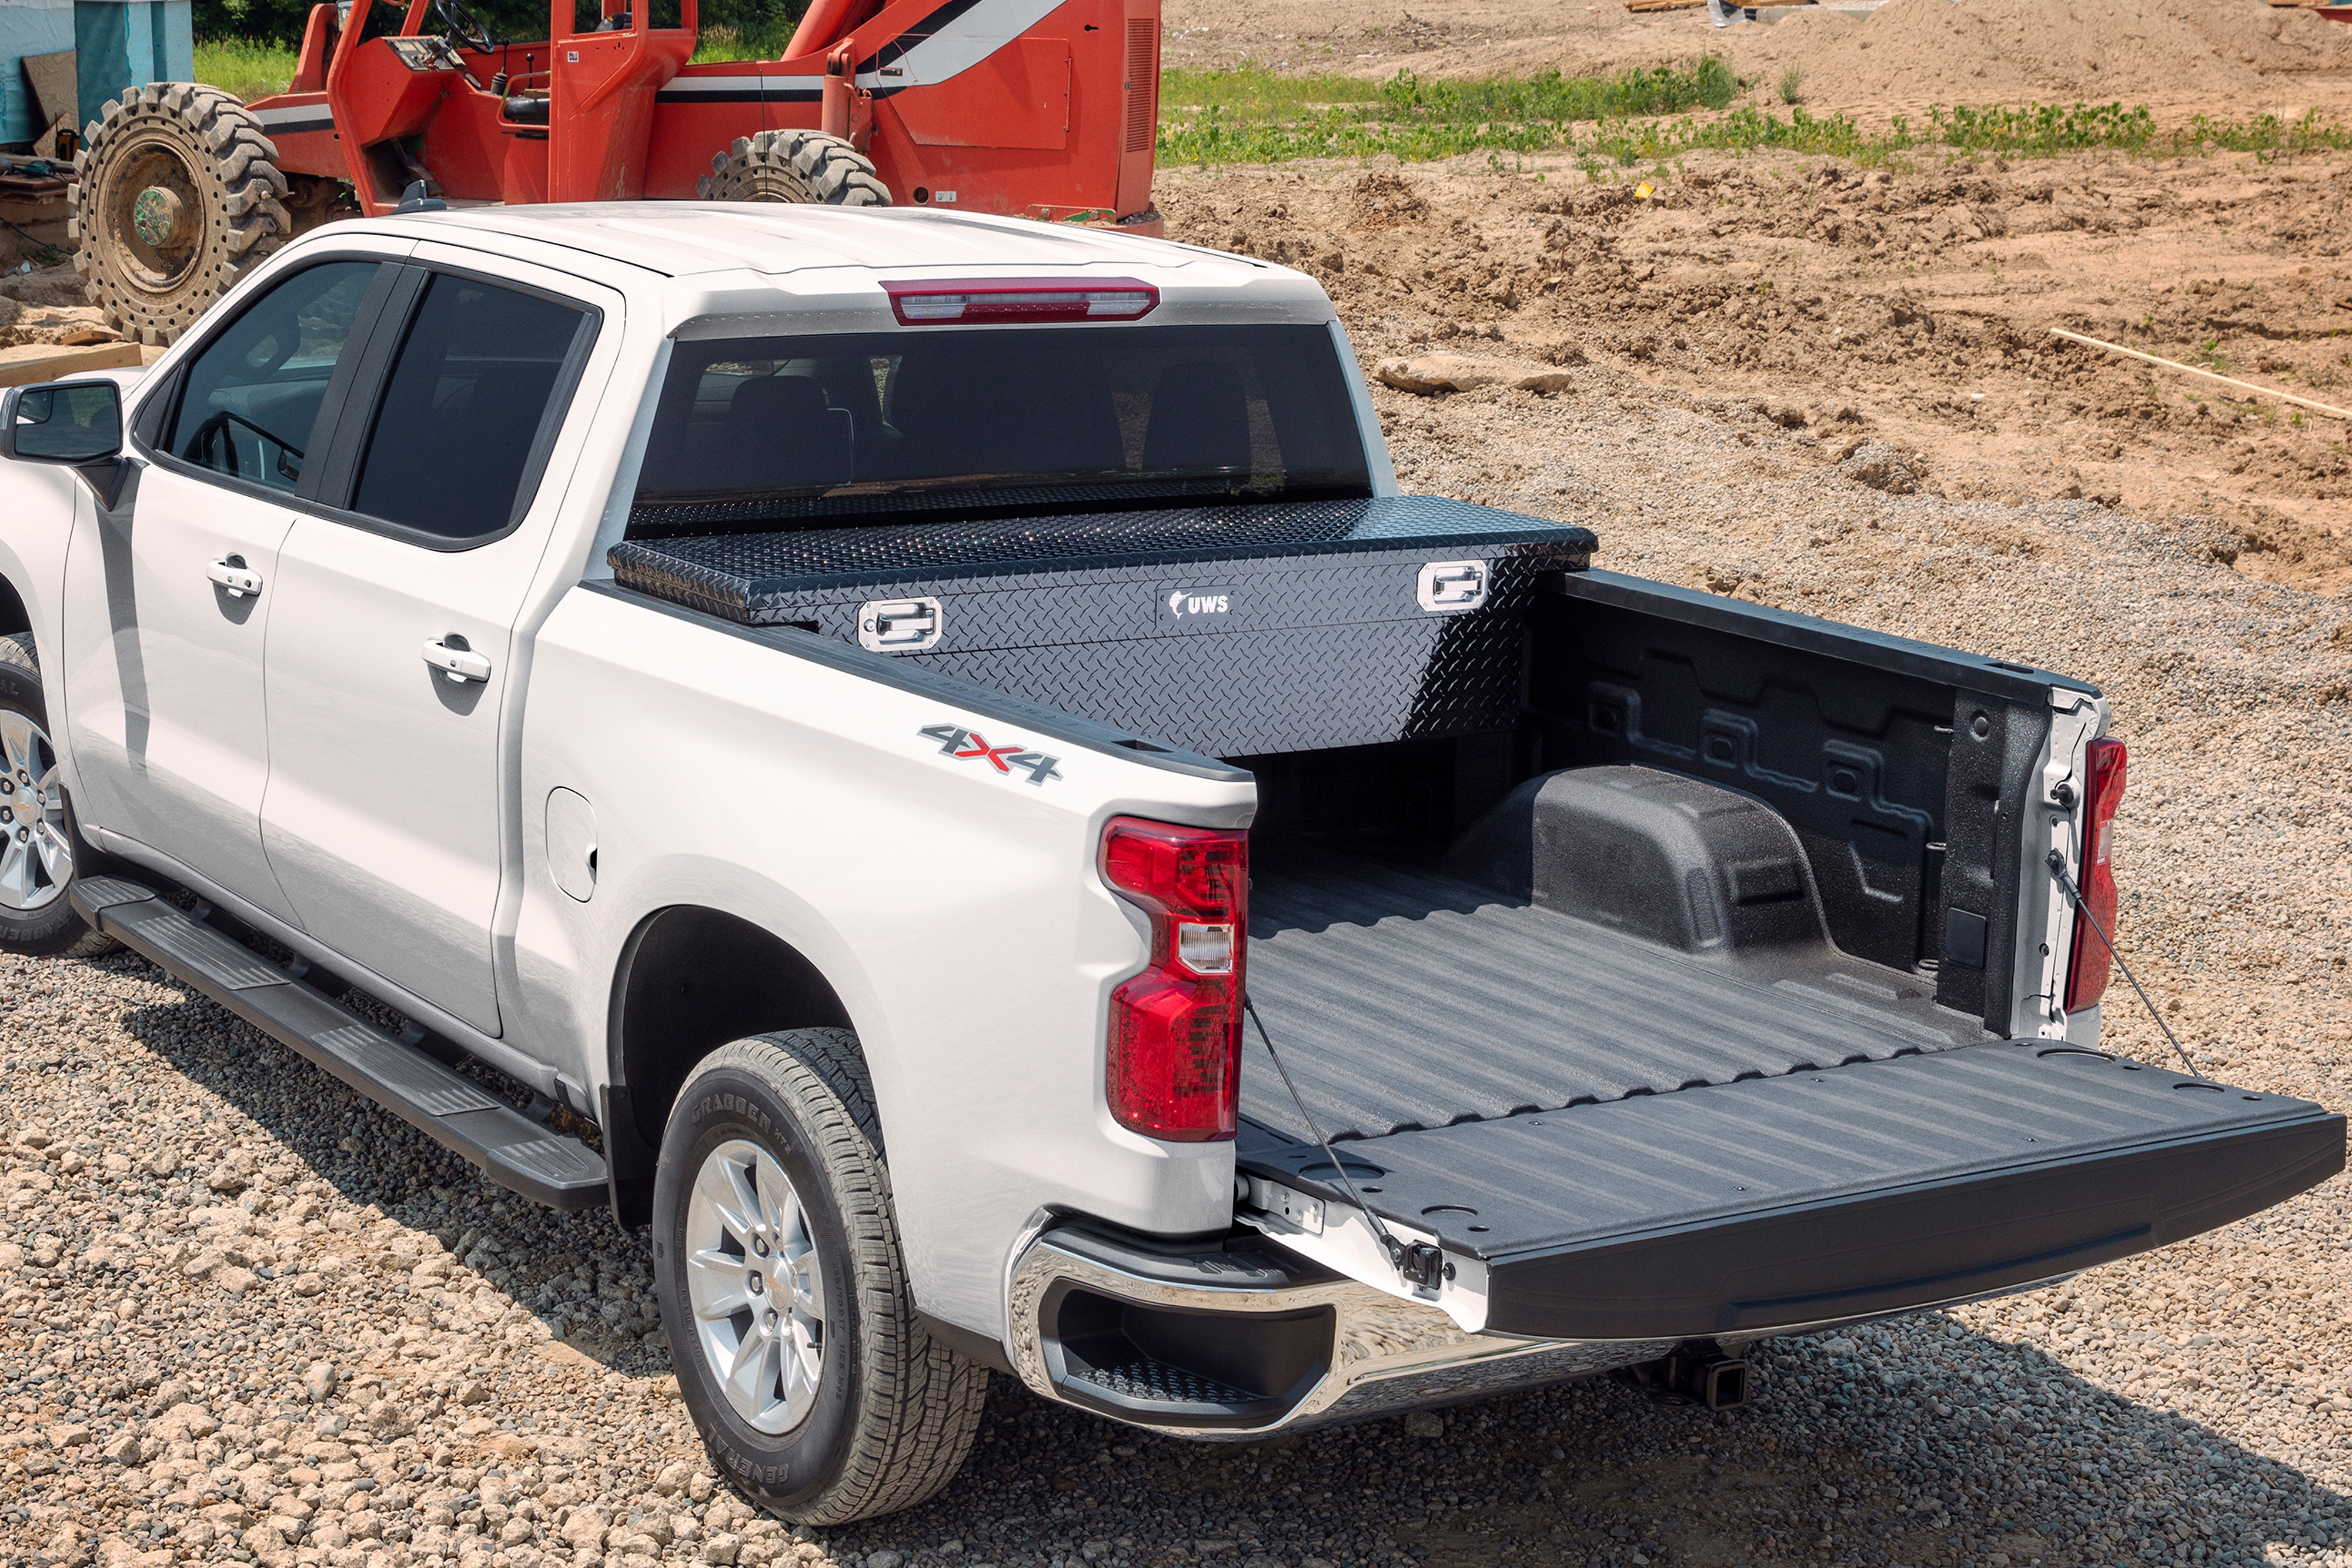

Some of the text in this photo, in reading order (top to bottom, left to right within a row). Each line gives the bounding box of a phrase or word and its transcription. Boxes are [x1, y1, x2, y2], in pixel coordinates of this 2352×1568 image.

[1188, 595, 1228, 614] UWS
[691, 1094, 771, 1134] GRABBER
[707, 1422, 789, 1484] GENERAL
